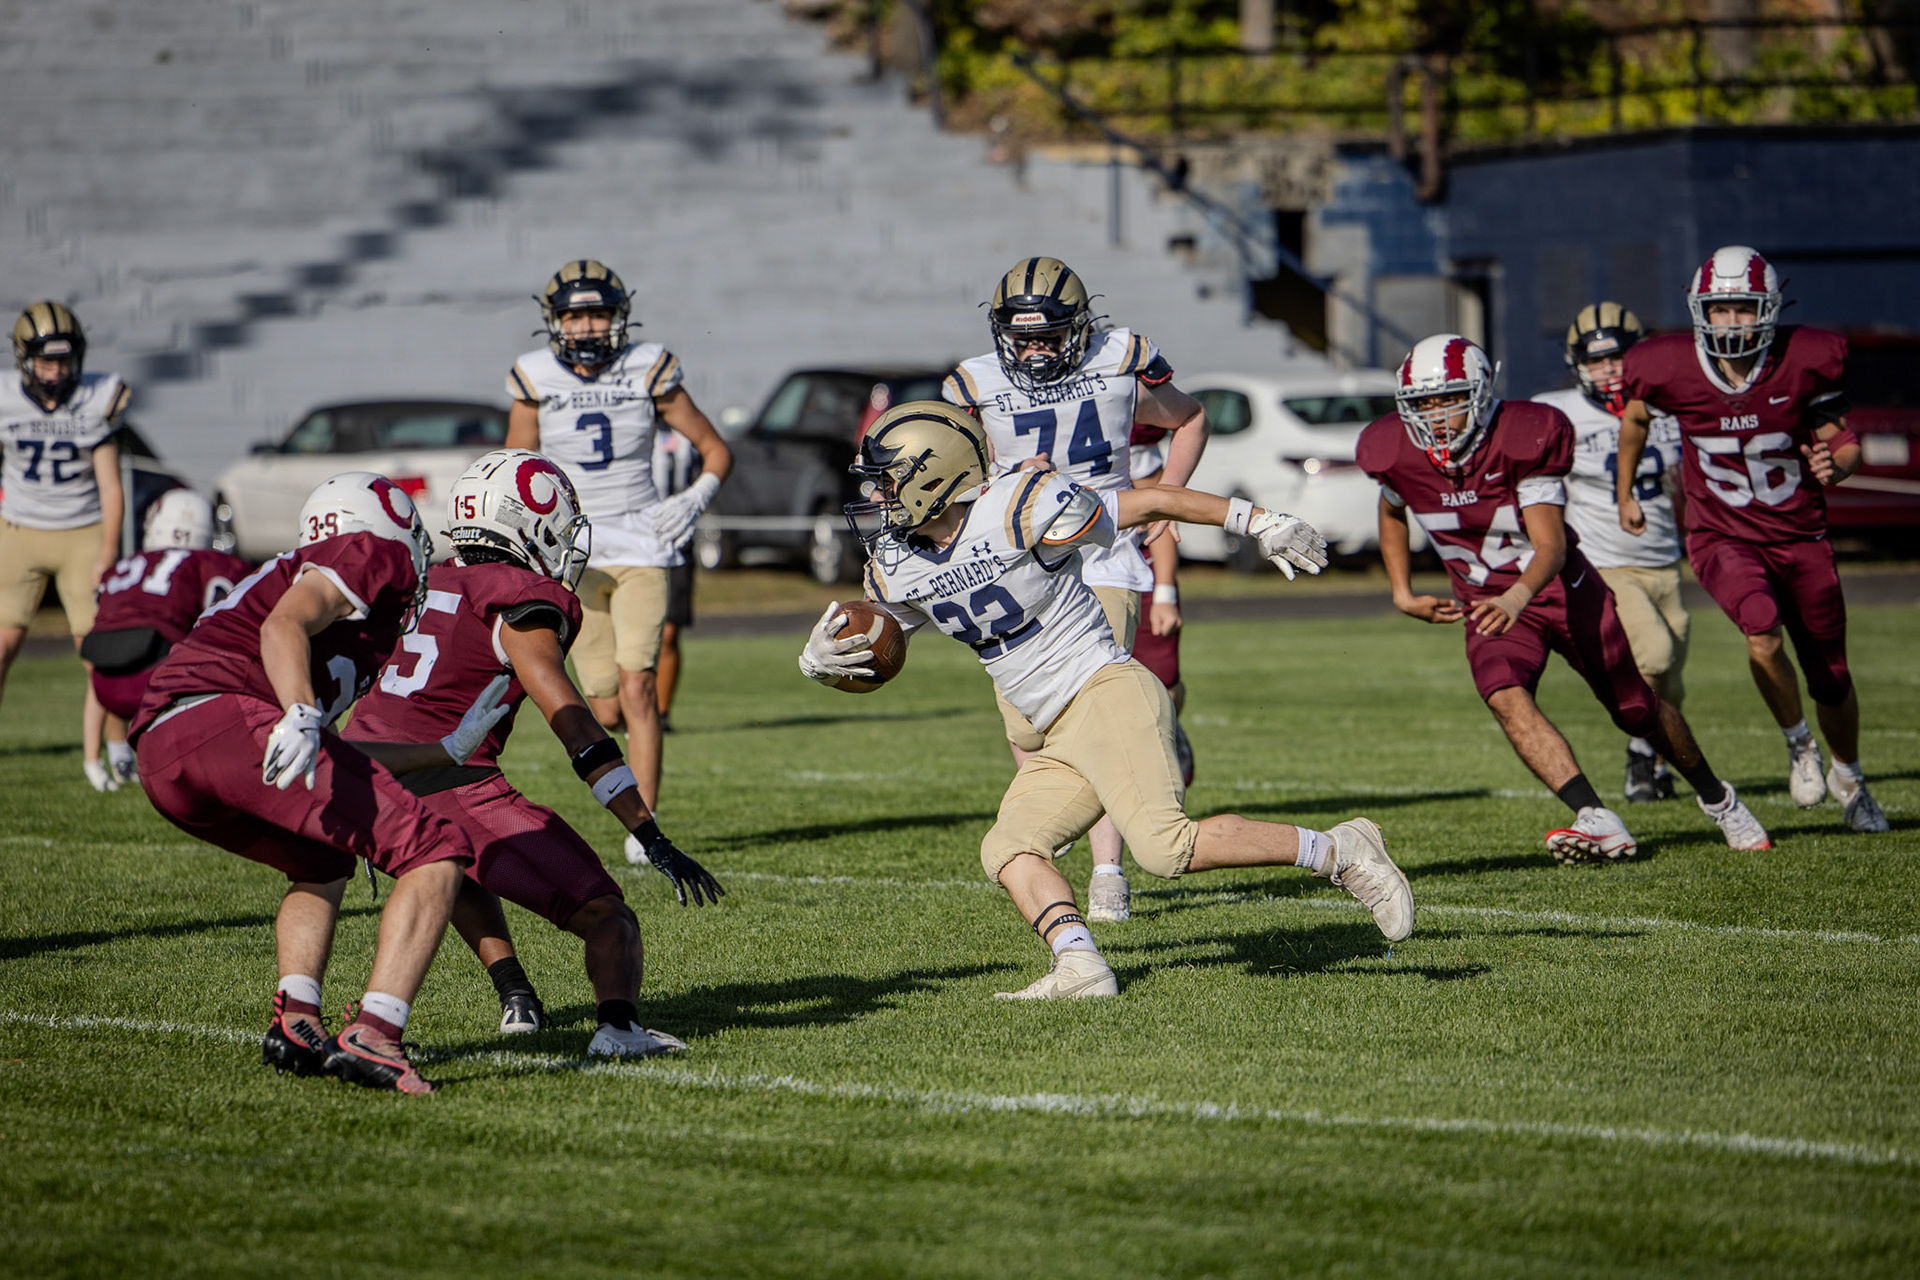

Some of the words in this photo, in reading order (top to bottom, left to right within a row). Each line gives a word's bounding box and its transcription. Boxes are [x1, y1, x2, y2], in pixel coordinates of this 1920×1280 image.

[995, 392, 1021, 412] ST.
[1720, 414, 1759, 431] RAMS
[575, 412, 614, 471] 3
[1013, 398, 1113, 477] 74
[16, 440, 79, 483] 72
[1689, 431, 1801, 507] 56
[455, 495, 476, 520] 15
[1440, 490, 1479, 507] RAMS
[309, 513, 339, 541] 39
[1415, 504, 1536, 587] 54
[929, 555, 1008, 599] BERNARD'S
[932, 584, 1044, 660] 22
